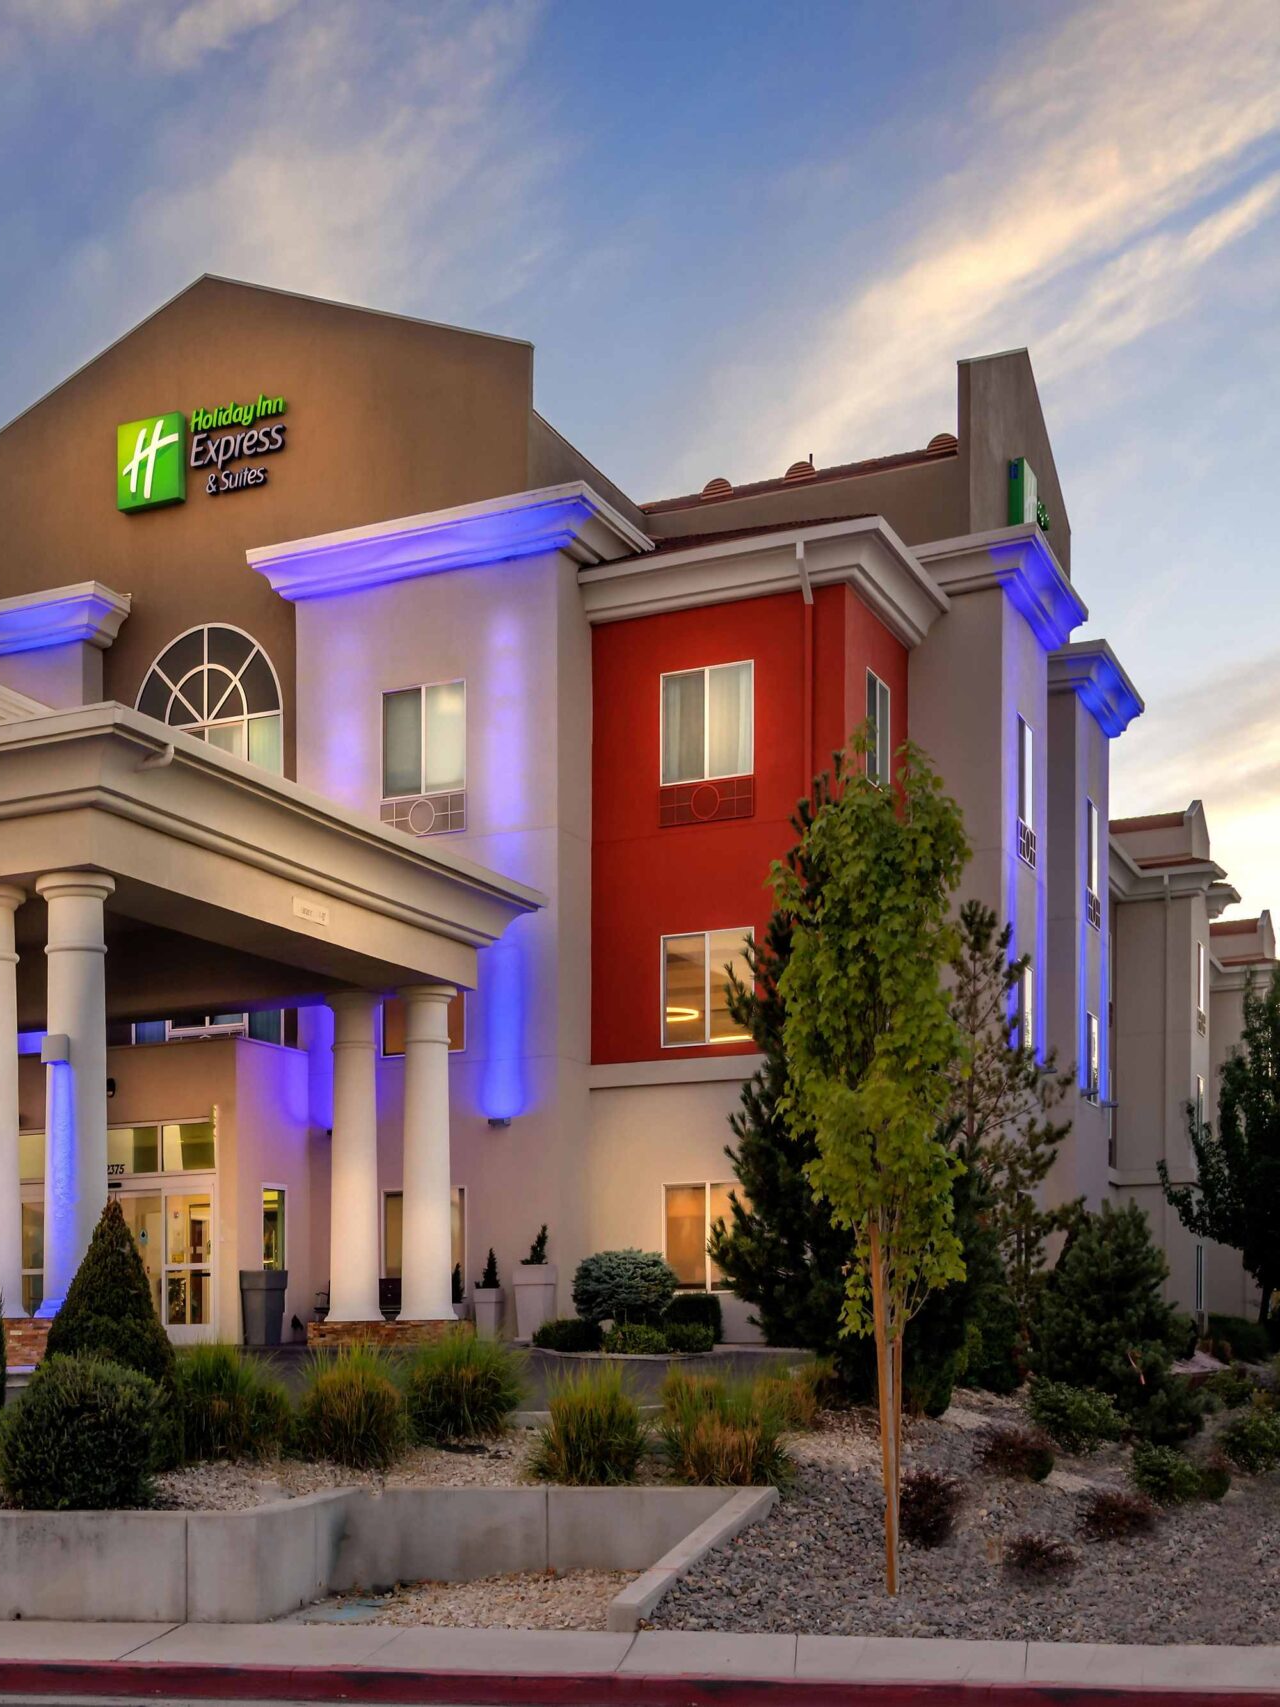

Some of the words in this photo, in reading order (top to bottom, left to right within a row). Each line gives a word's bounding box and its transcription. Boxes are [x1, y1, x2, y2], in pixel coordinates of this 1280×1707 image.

[190, 401, 255, 433] Holiday
[256, 393, 286, 418] Inn
[190, 424, 285, 469] Express
[206, 473, 217, 494] &
[220, 467, 265, 491] Suites
